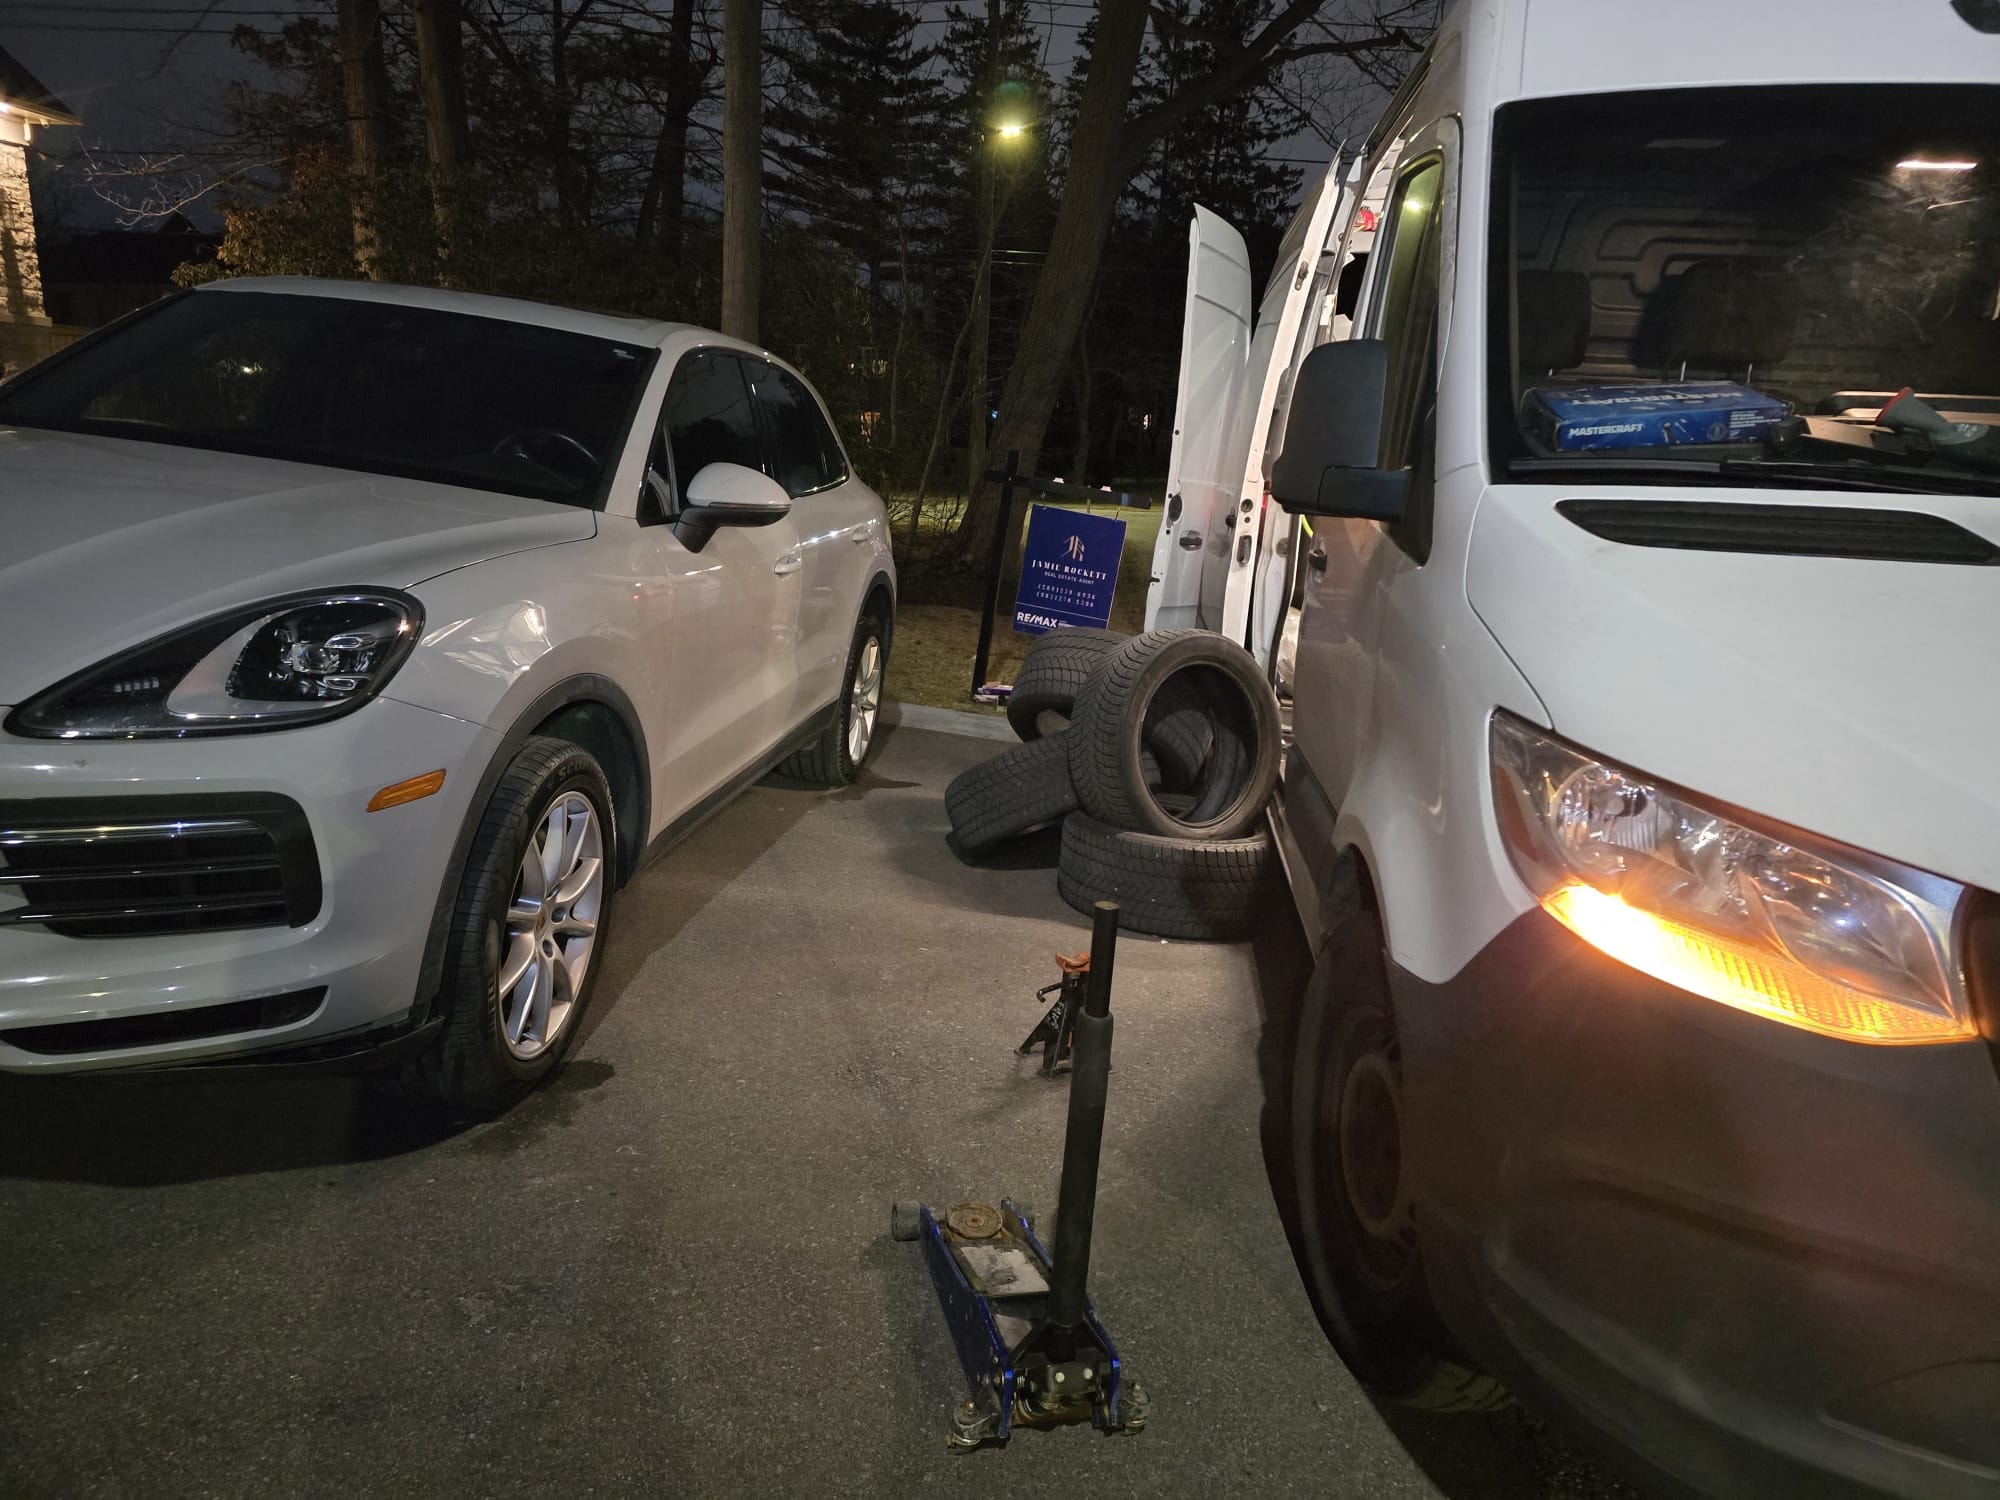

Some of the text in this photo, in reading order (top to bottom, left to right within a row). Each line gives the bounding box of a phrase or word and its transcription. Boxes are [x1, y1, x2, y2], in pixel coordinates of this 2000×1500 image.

[1568, 423, 1644, 438] MASTERCRAFT
[1032, 559, 1107, 580] JAMIE ROCKETT
[1016, 612, 1058, 628] RE/MAX
